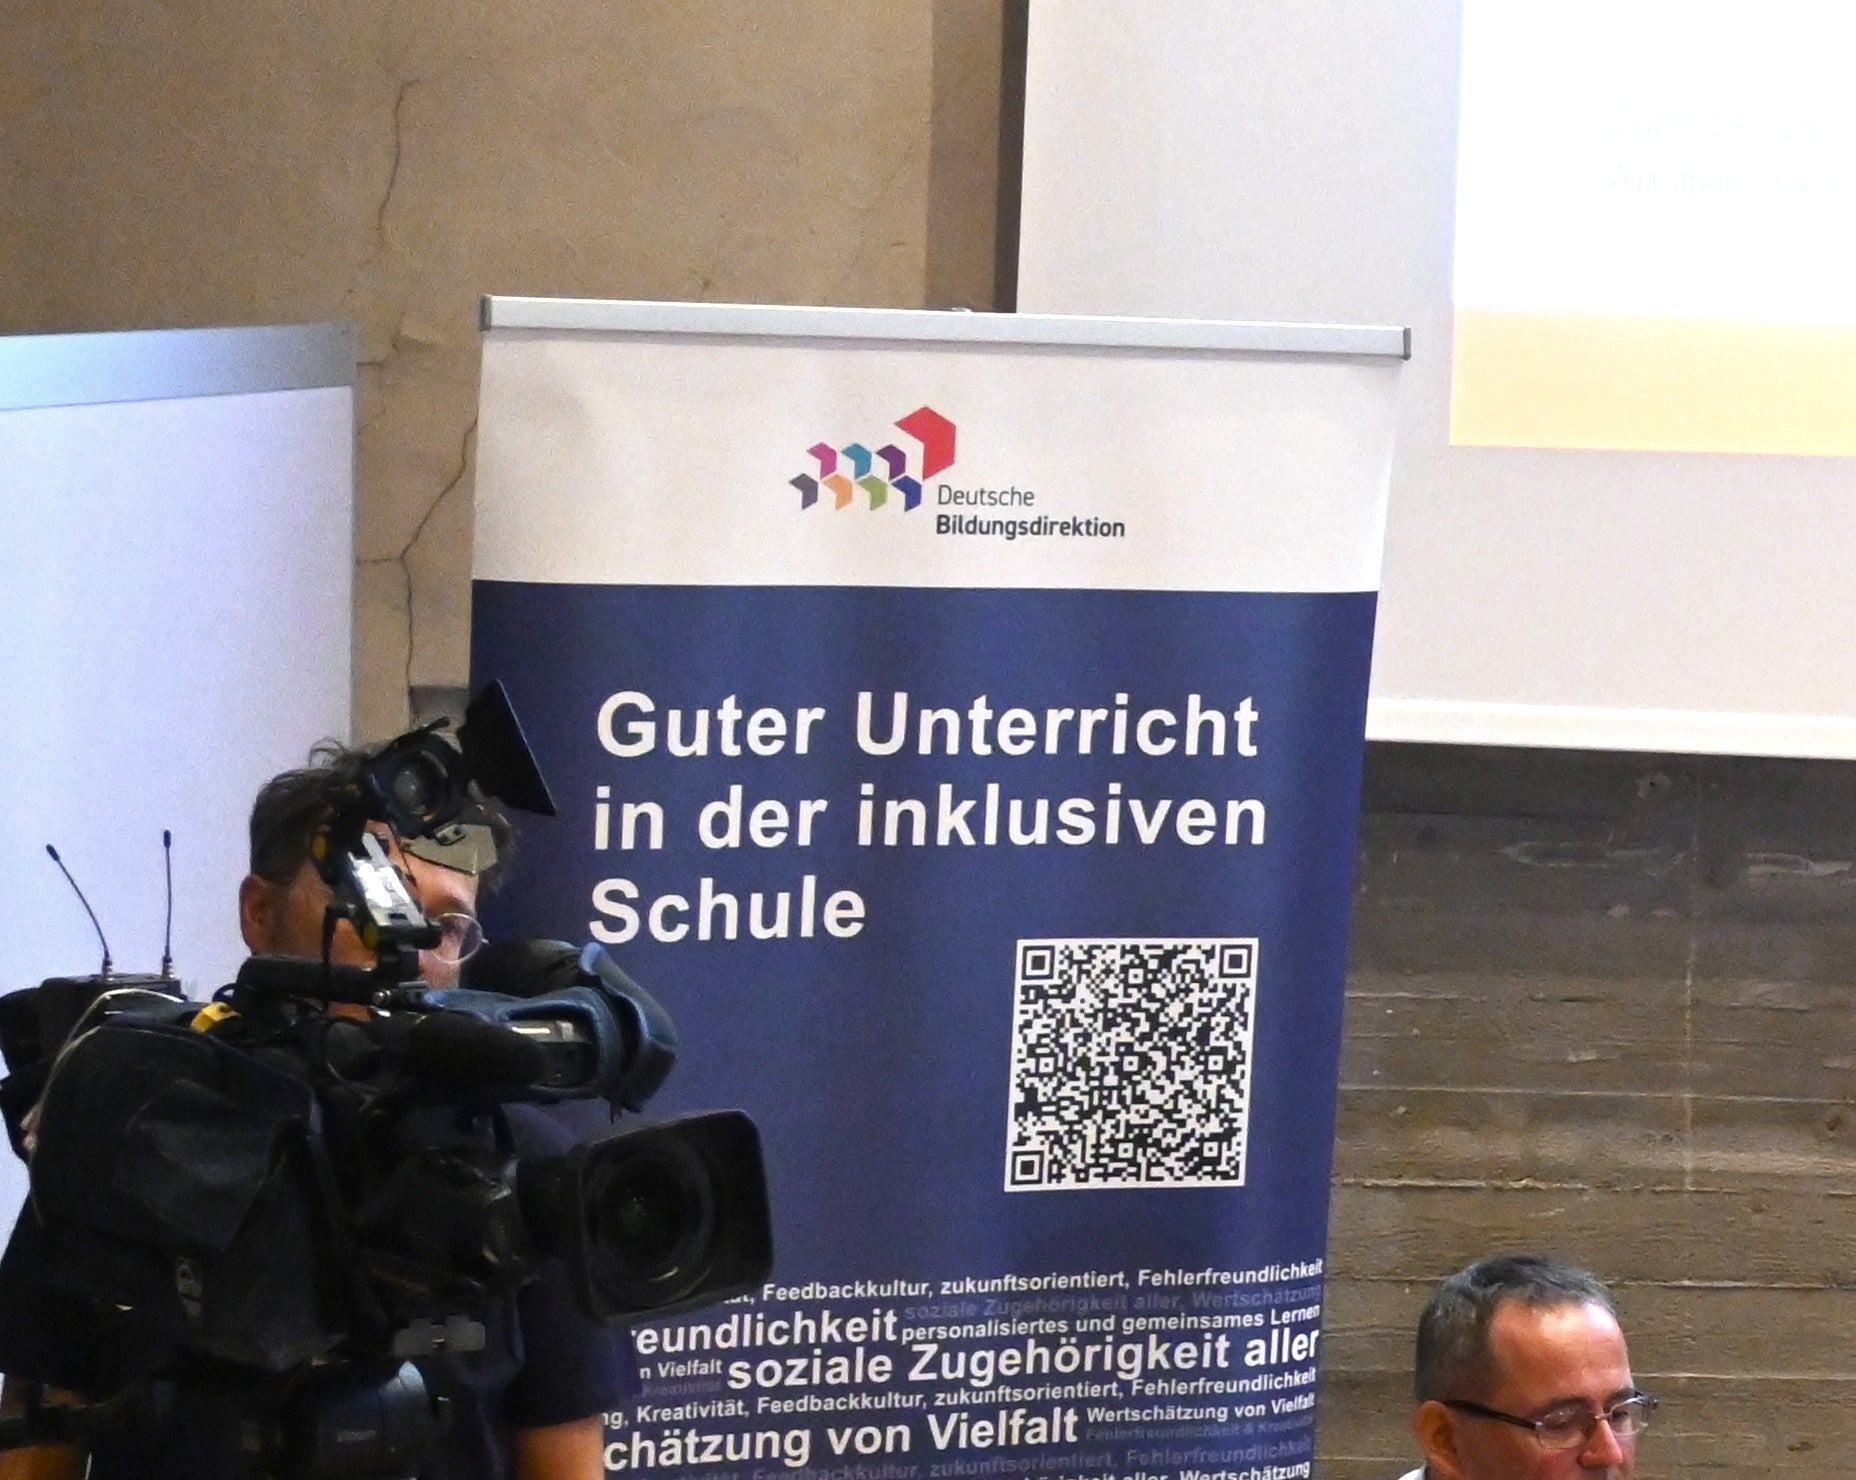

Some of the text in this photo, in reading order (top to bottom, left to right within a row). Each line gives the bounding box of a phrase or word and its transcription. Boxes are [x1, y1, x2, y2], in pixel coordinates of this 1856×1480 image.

[938, 484, 1035, 508] Deutsche
[936, 514, 1126, 541] Bildungsdirektion
[599, 690, 1258, 758] Guter Unterricht
[594, 784, 1266, 850] in der inklusiven
[589, 876, 866, 944] Schule
[762, 1259, 1323, 1302] Feedbackkultur, zukunftsorientiert, Fehlerfreundlichkeit
[632, 1309, 898, 1354] eundlichkeit
[902, 1304, 1320, 1345] personalisiertes und gemeinsames Lernen
[658, 1359, 722, 1378] Vielfalt
[727, 1346, 892, 1389] soziale
[908, 1334, 1231, 1387] Zugehörigkeit
[1244, 1328, 1320, 1367] aller
[637, 1401, 749, 1424] Kreativität,
[757, 1392, 926, 1414] Feedbackkultur,
[933, 1382, 1123, 1406] zukunftsorientiert,
[1131, 1368, 1316, 1396] Fehlerfreundlichkeit
[1087, 1392, 1315, 1423] Wertschätzung von Vielfalt
[604, 1426, 812, 1468] chätzung
[828, 1424, 910, 1455] von
[927, 1407, 1078, 1450] Vielfalt
